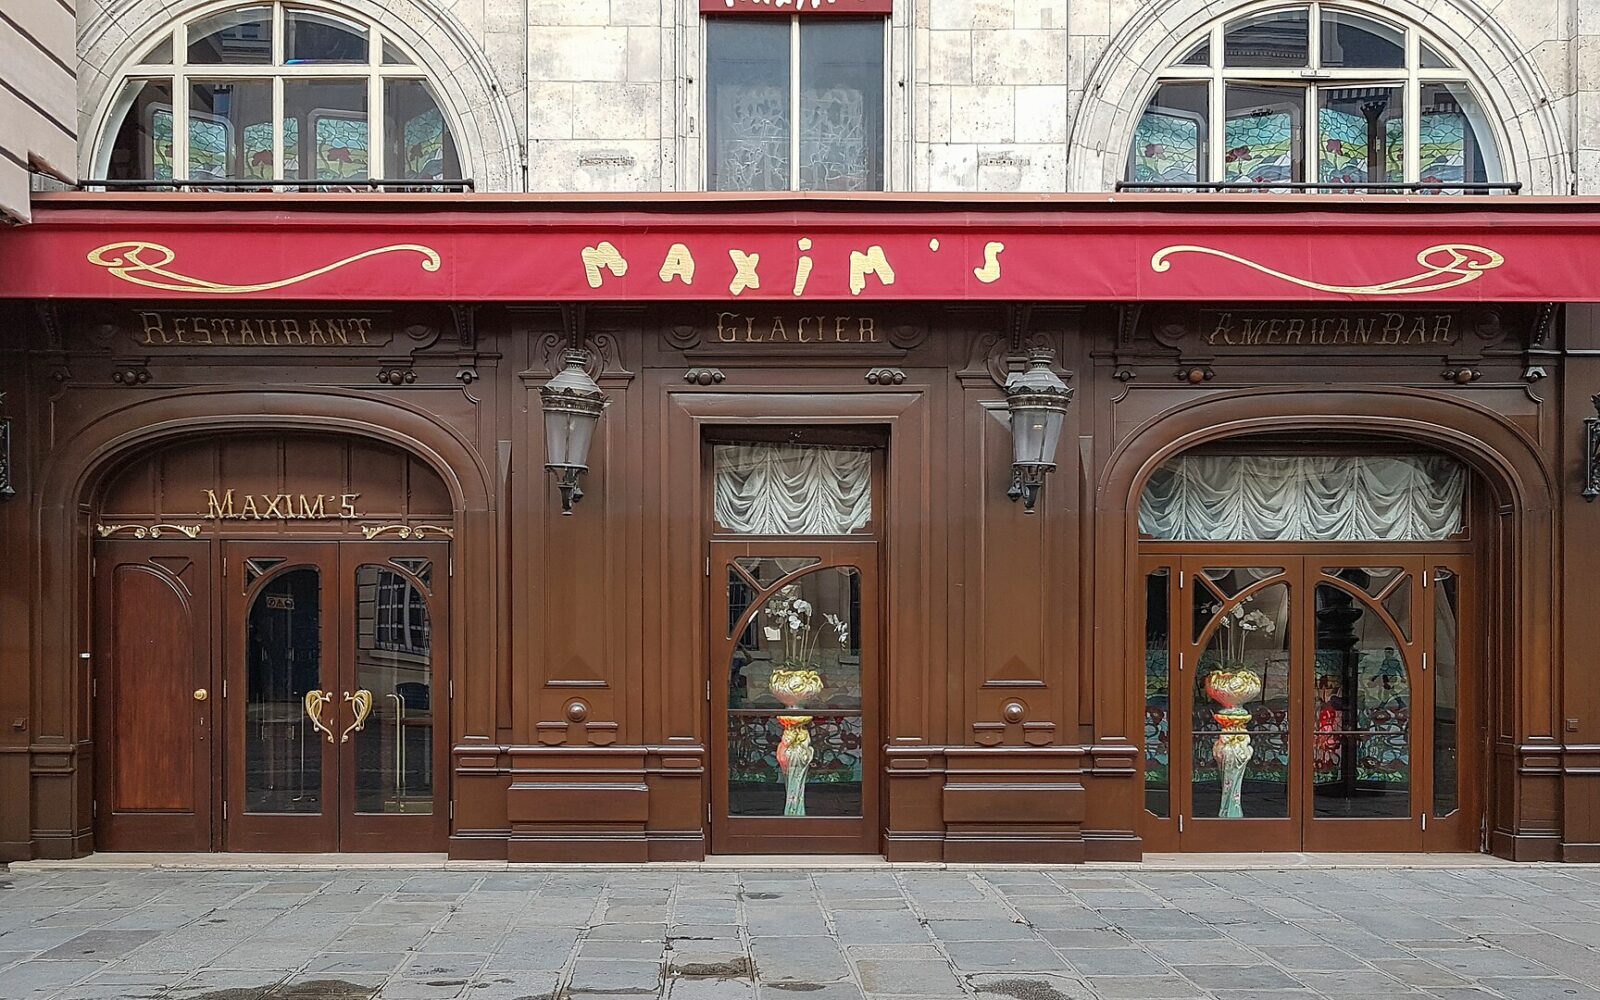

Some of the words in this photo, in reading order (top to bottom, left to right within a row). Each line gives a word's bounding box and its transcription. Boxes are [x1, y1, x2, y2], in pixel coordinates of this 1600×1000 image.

[138, 311, 372, 345] RESTAURANT
[717, 312, 878, 343] GLACIER
[1208, 312, 1376, 345] AMERICAN
[1375, 312, 1453, 345] BAR
[202, 488, 361, 520] MAXIM'S
